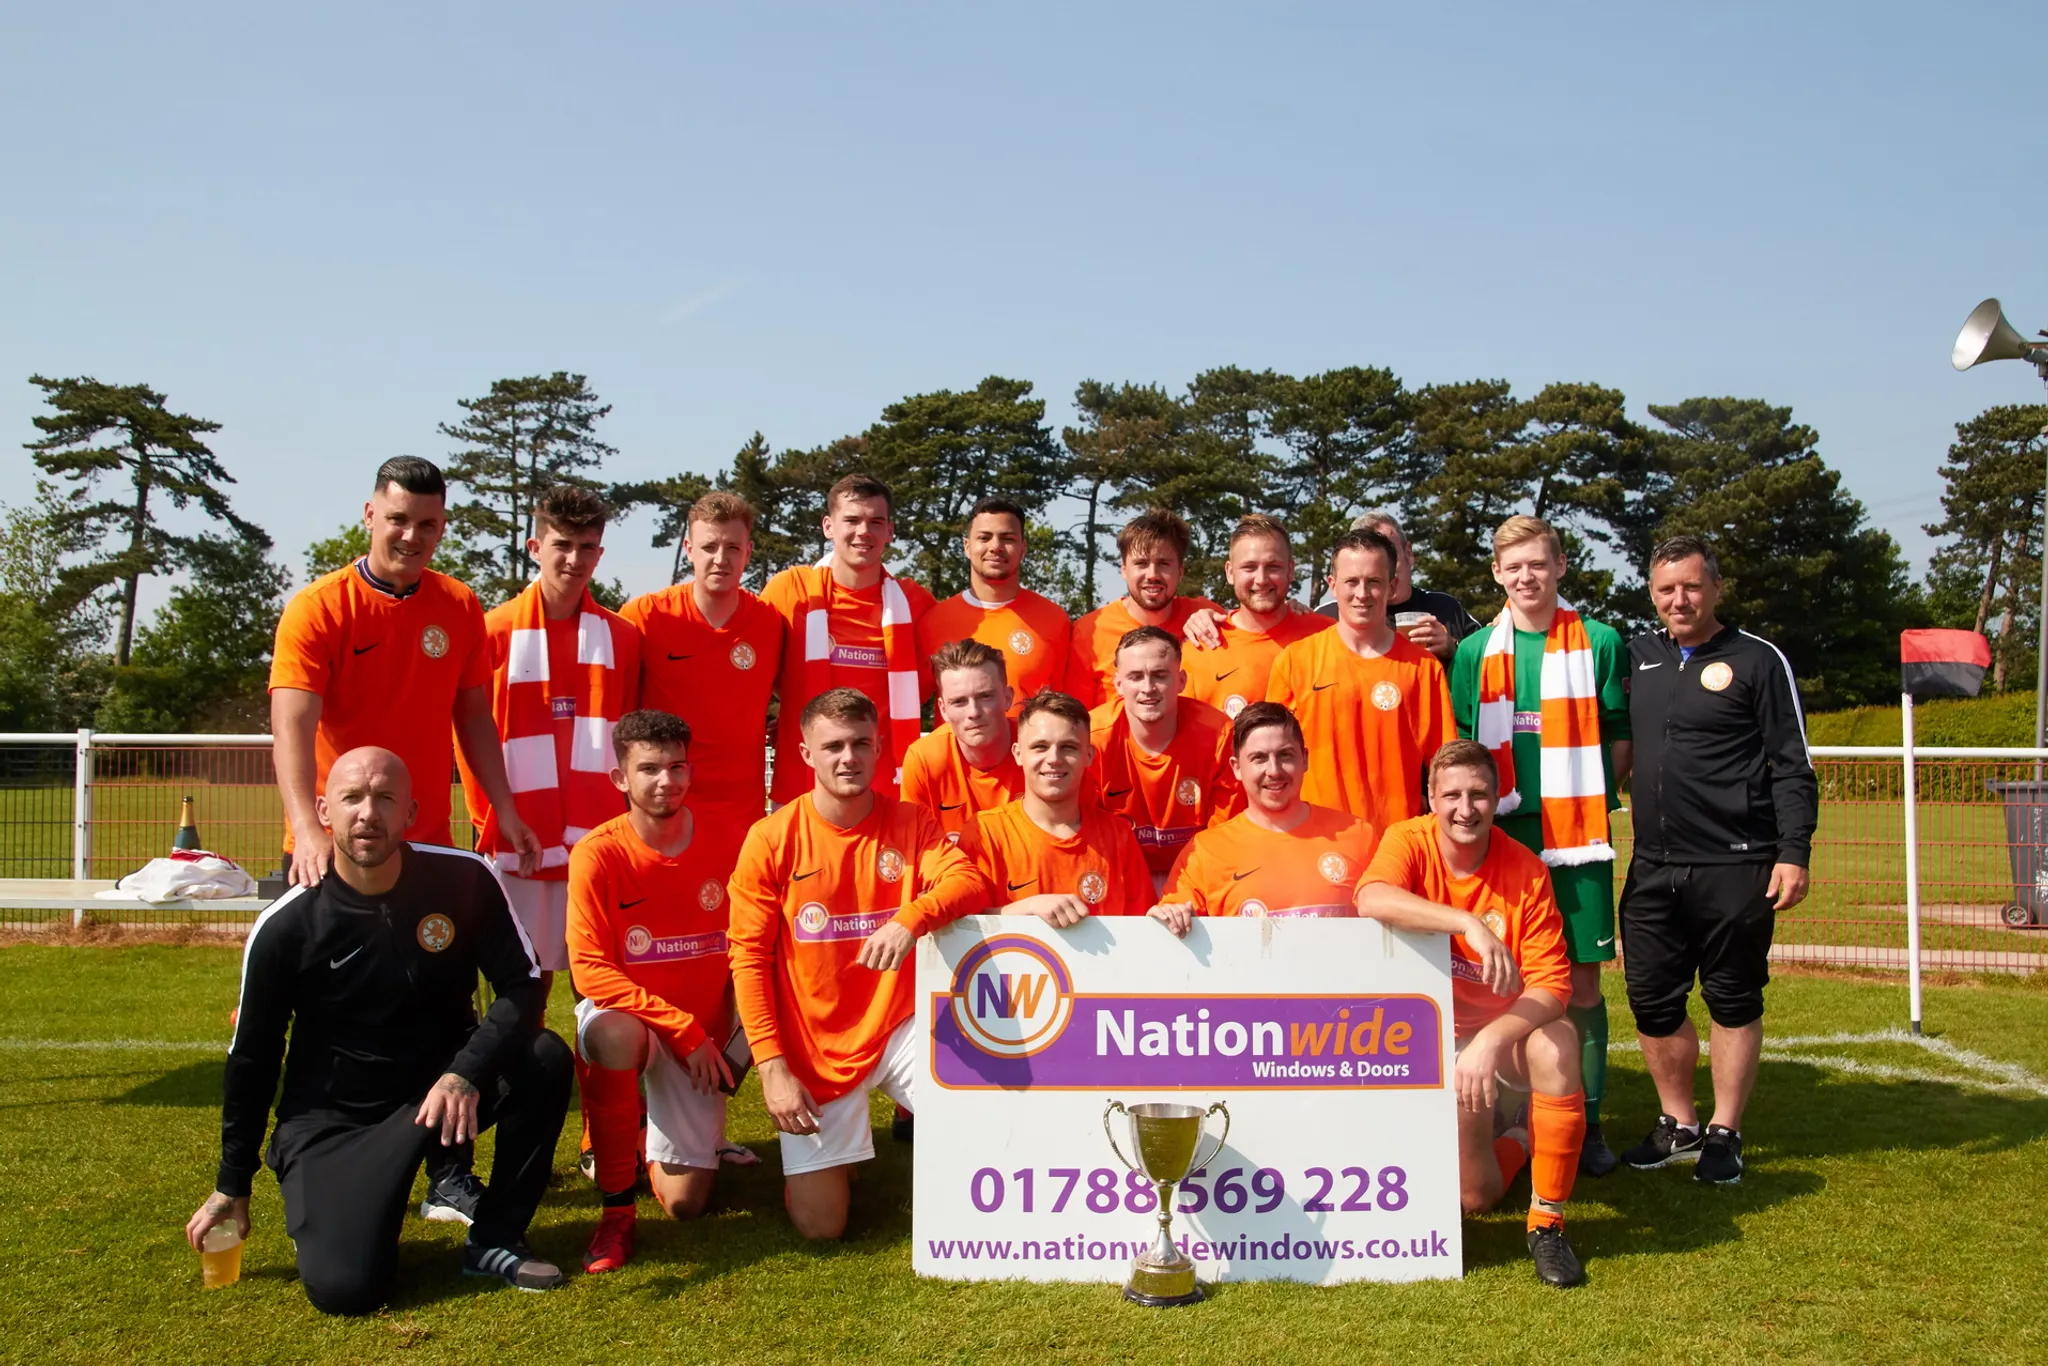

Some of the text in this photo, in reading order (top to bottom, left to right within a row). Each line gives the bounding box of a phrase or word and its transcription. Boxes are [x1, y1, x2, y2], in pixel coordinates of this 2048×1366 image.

[1514, 715, 1541, 726] Natio
[805, 912, 822, 924] NW
[833, 913, 892, 932] Nationwi
[629, 935, 645, 947] NW
[977, 973, 1048, 1019] NW
[1096, 1007, 1412, 1057] Nationwide
[1252, 1060, 1410, 1079] Windows & Doors
[971, 1166, 1408, 1214] 01788 569 228
[929, 1231, 1448, 1261] www.nationwdewindows.co.uk
